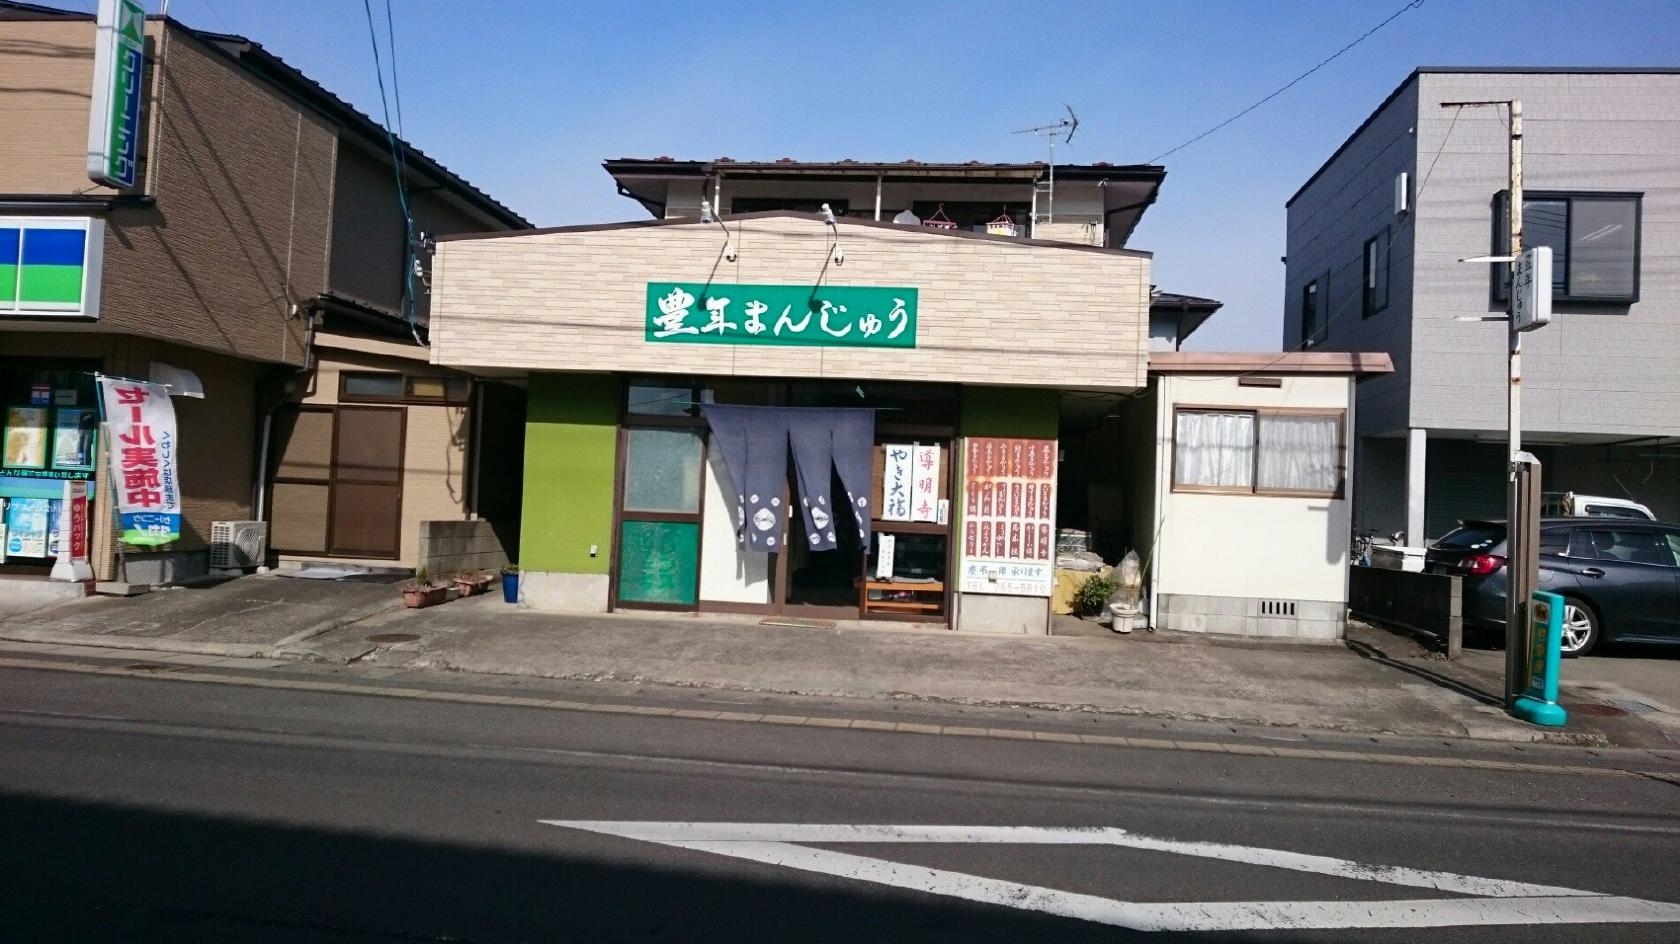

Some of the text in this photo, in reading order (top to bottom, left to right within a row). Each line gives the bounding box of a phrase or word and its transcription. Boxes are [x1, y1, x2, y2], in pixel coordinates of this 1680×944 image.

[115, 50, 137, 179] クリーニング
[652, 286, 909, 339] 豊年まんじゅう
[888, 449, 908, 517] やき大福
[72, 504, 81, 551] ゆうパック
